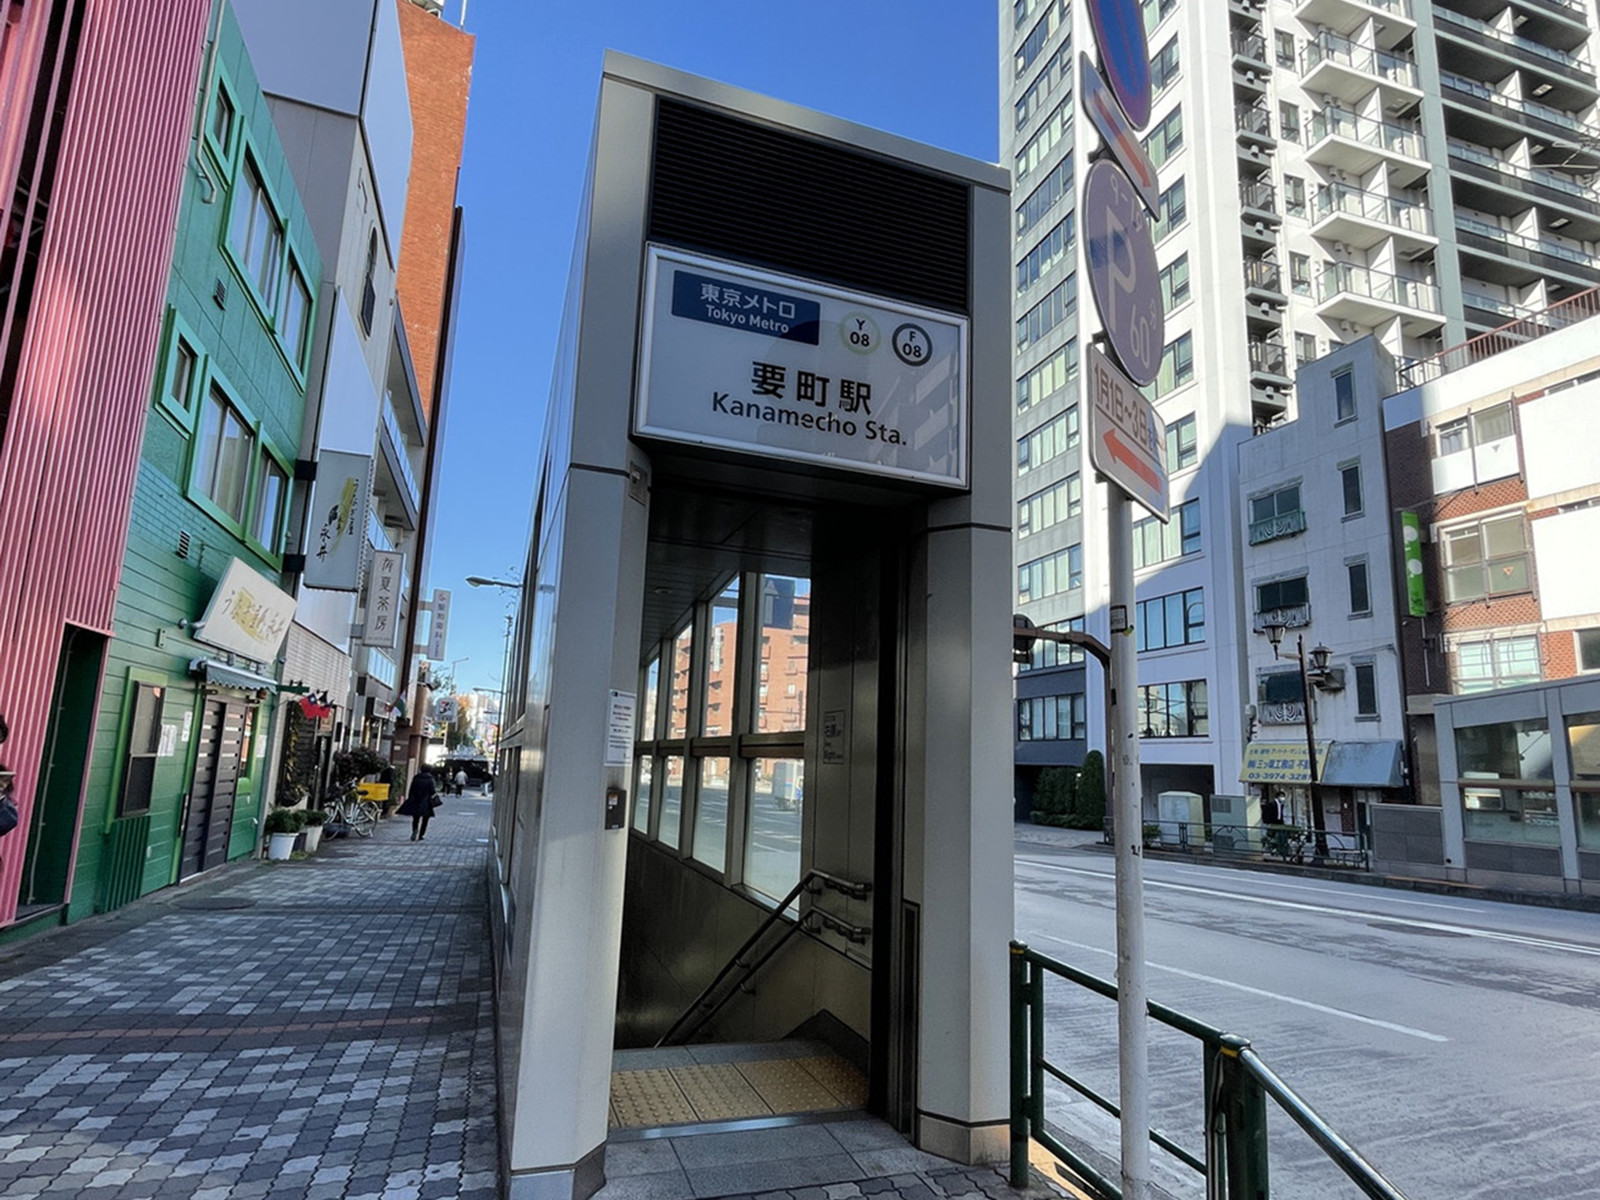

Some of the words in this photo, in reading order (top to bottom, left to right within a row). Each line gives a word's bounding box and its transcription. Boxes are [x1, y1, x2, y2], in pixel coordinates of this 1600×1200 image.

[700, 283, 796, 319] 東京メトロ
[706, 304, 746, 325] Tokyo
[749, 314, 790, 334] Metro
[856, 318, 866, 331] Y
[849, 331, 870, 347] 08
[909, 330, 917, 342] F
[902, 343, 922, 358] 08
[752, 361, 872, 416] 要町駅
[712, 392, 857, 436] Kanamecho
[865, 420, 908, 446] Sta.
